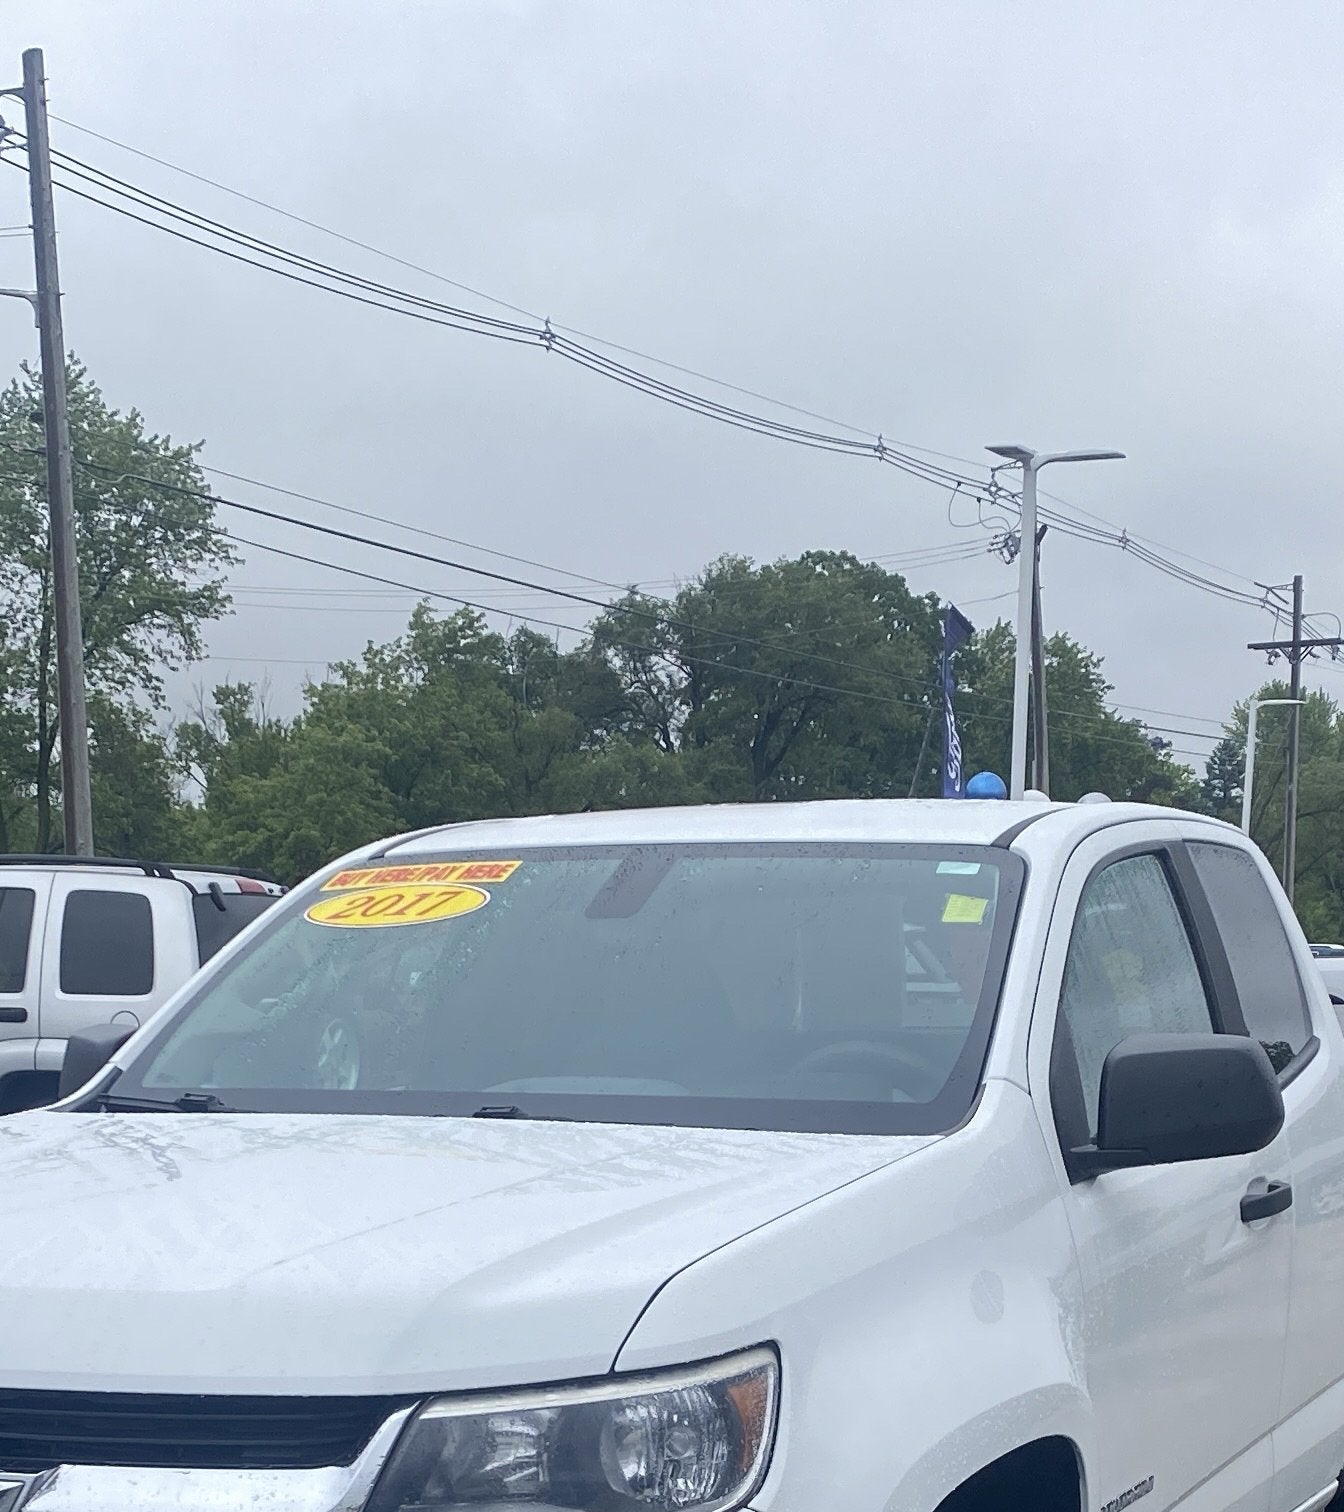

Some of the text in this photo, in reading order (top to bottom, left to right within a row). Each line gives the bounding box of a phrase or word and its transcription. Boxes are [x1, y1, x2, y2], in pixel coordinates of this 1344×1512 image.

[329, 871, 372, 888] BUY
[456, 863, 516, 881] HERE
[324, 890, 465, 920] 2017
